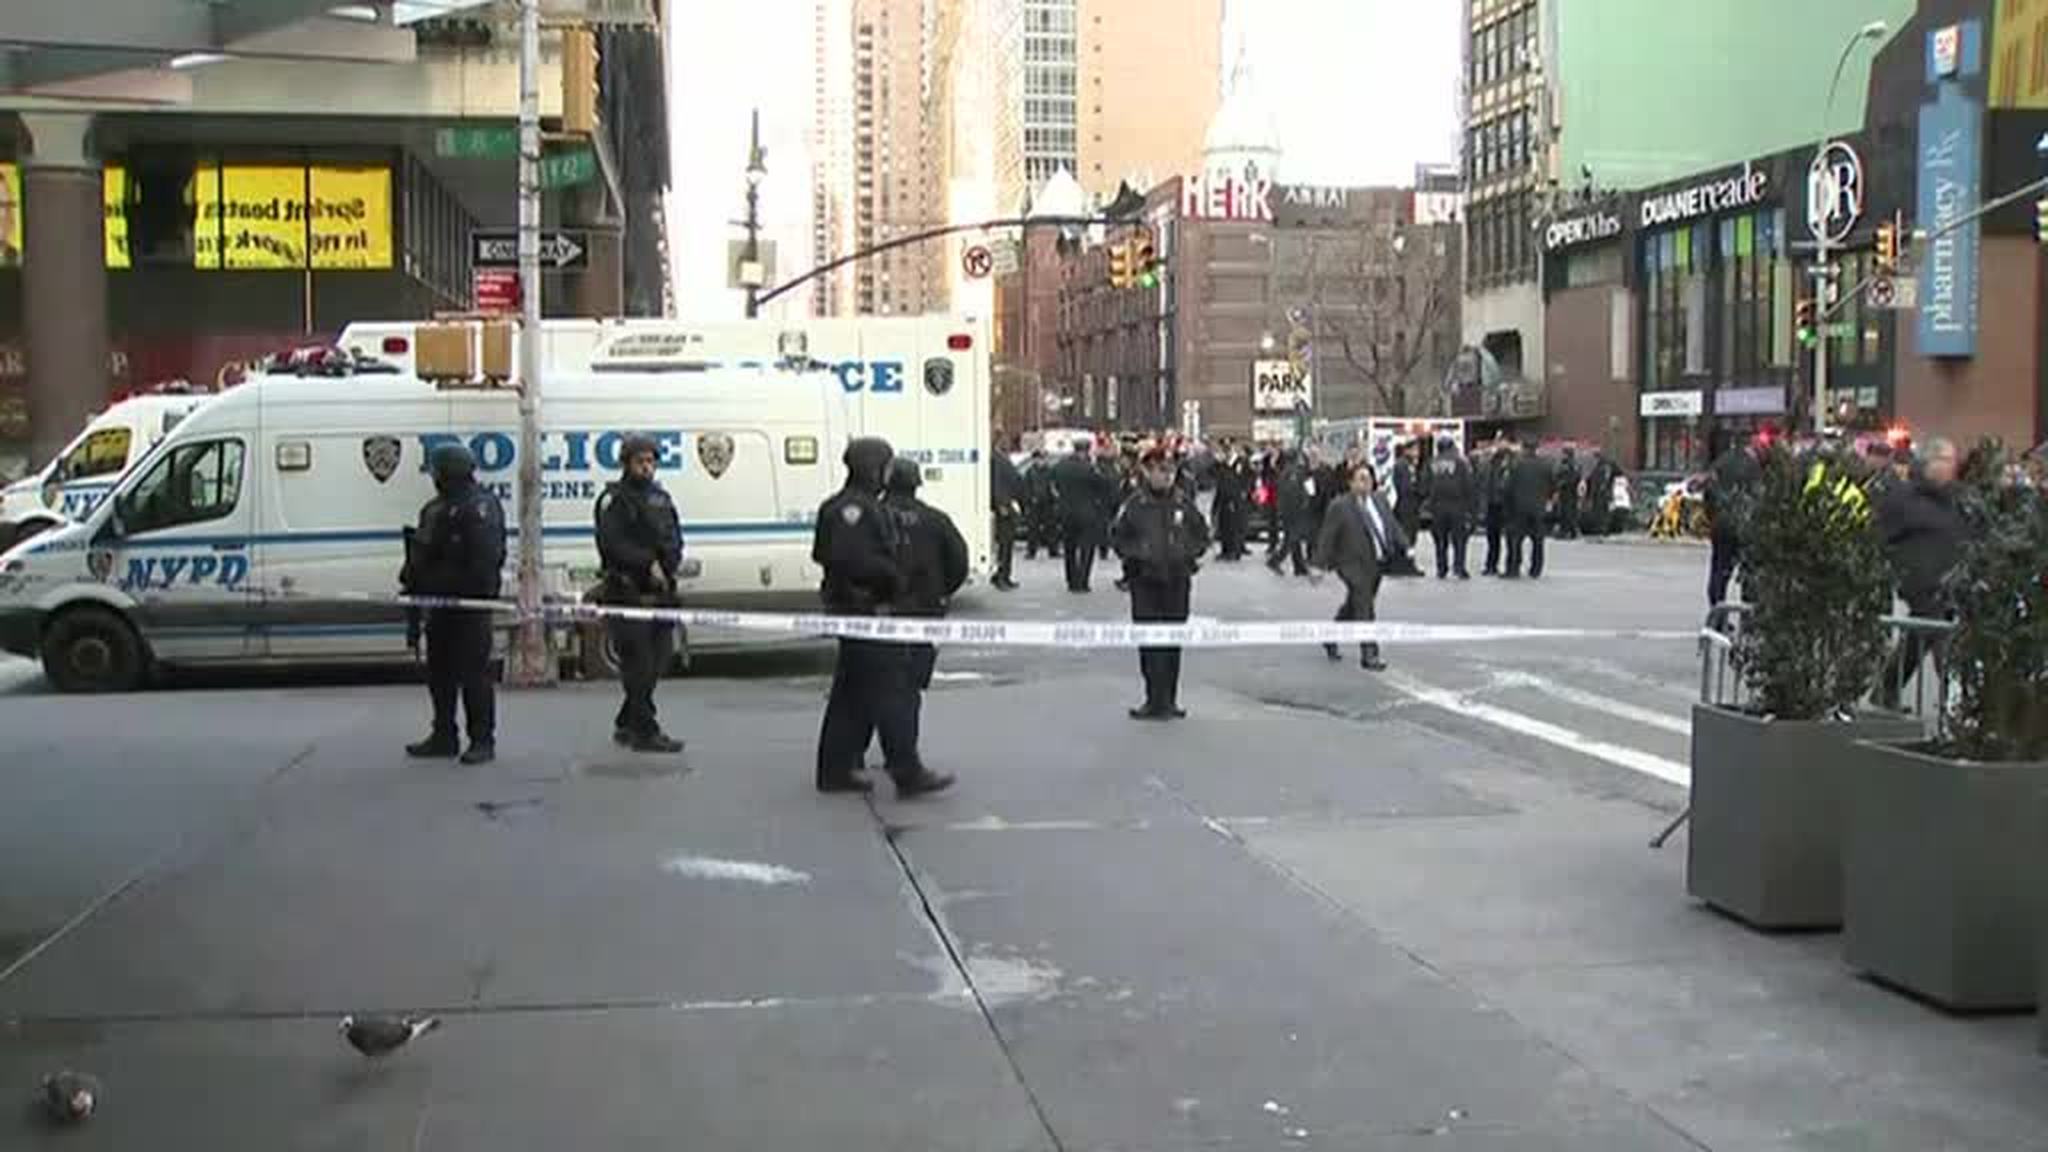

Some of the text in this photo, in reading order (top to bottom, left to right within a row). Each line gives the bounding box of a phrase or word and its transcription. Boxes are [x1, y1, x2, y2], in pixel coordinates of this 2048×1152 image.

[487, 241, 519, 259] ON
[1259, 373, 1307, 393] PARK
[62, 491, 109, 523] NY
[121, 553, 250, 591] NYPD
